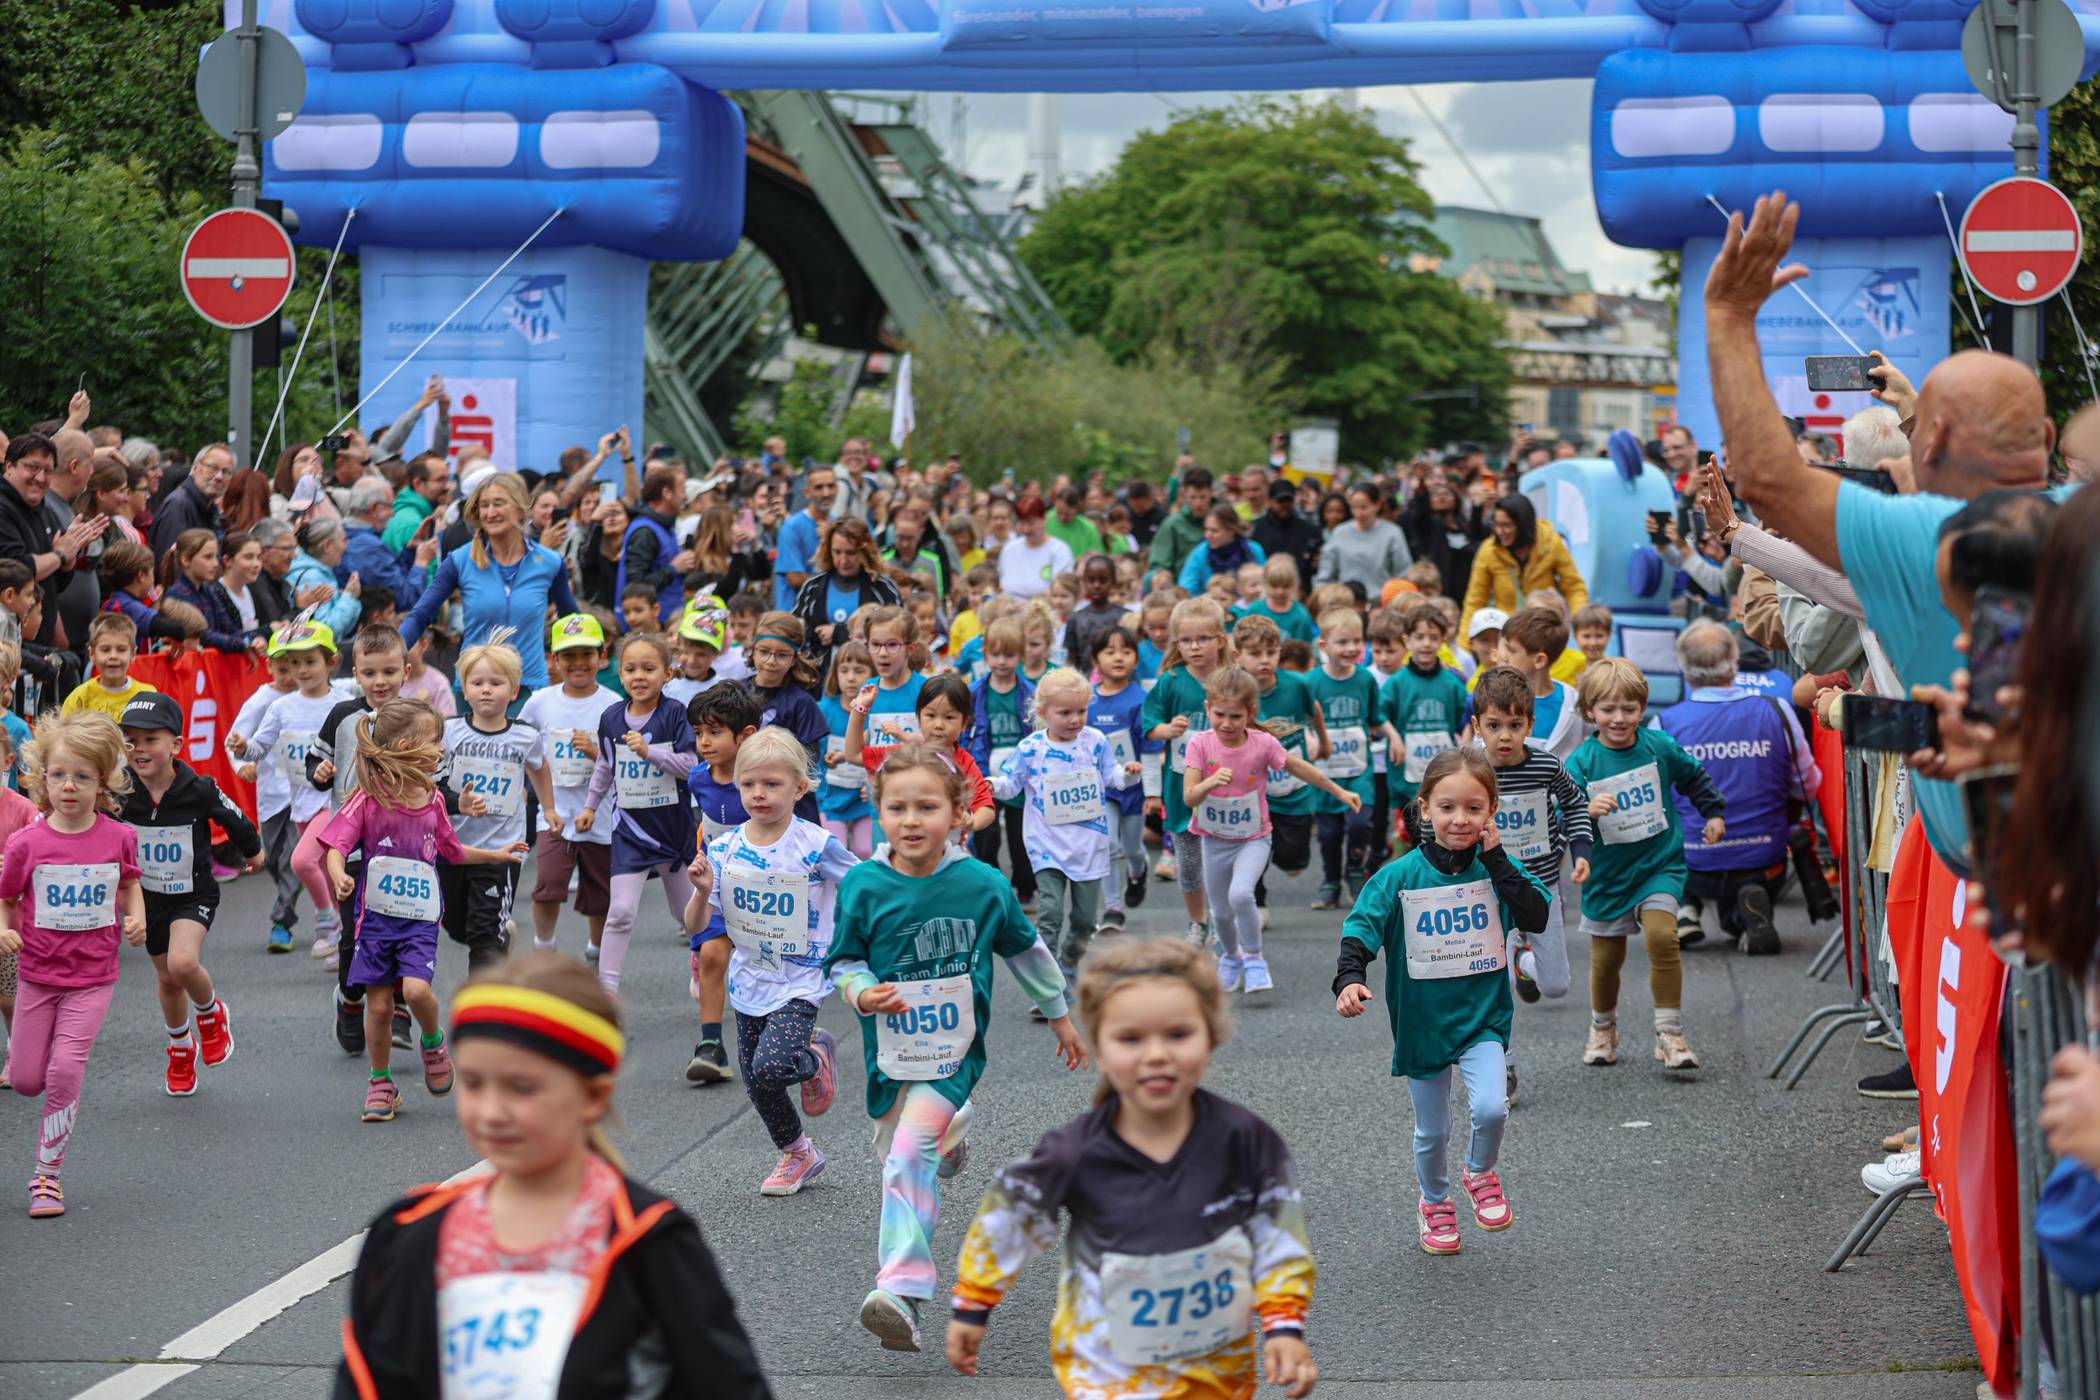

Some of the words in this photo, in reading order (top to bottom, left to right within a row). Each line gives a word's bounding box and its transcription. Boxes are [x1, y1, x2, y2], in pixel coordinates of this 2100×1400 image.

[1734, 673, 1776, 688] ERA-
[126, 700, 156, 713] RMANY
[1331, 739, 1359, 755] 040
[1683, 740, 1771, 761] FOTOGRAF
[649, 795, 670, 806] 7873
[1049, 783, 1098, 806] 10352
[1610, 782, 1656, 814] 035
[1206, 806, 1252, 825] 6184
[1494, 808, 1537, 830] 994
[136, 842, 182, 863] 100
[1519, 845, 1541, 857] 1994
[46, 883, 107, 908] 8446
[162, 882, 184, 892] 1100
[378, 873, 431, 900] 4355
[732, 886, 795, 917] 8520
[1416, 902, 1489, 937] 4056
[742, 925, 784, 939] Bambini-Lauf
[780, 942, 796, 953] 20
[1430, 949, 1483, 962] Bambini-Lauf
[895, 968, 931, 982] Team
[933, 958, 968, 978] Junio
[1468, 956, 1498, 972] 4056
[886, 1002, 959, 1036] 4050
[897, 1050, 952, 1063] Bambini-Lauf
[1129, 1268, 1235, 1327] 2738
